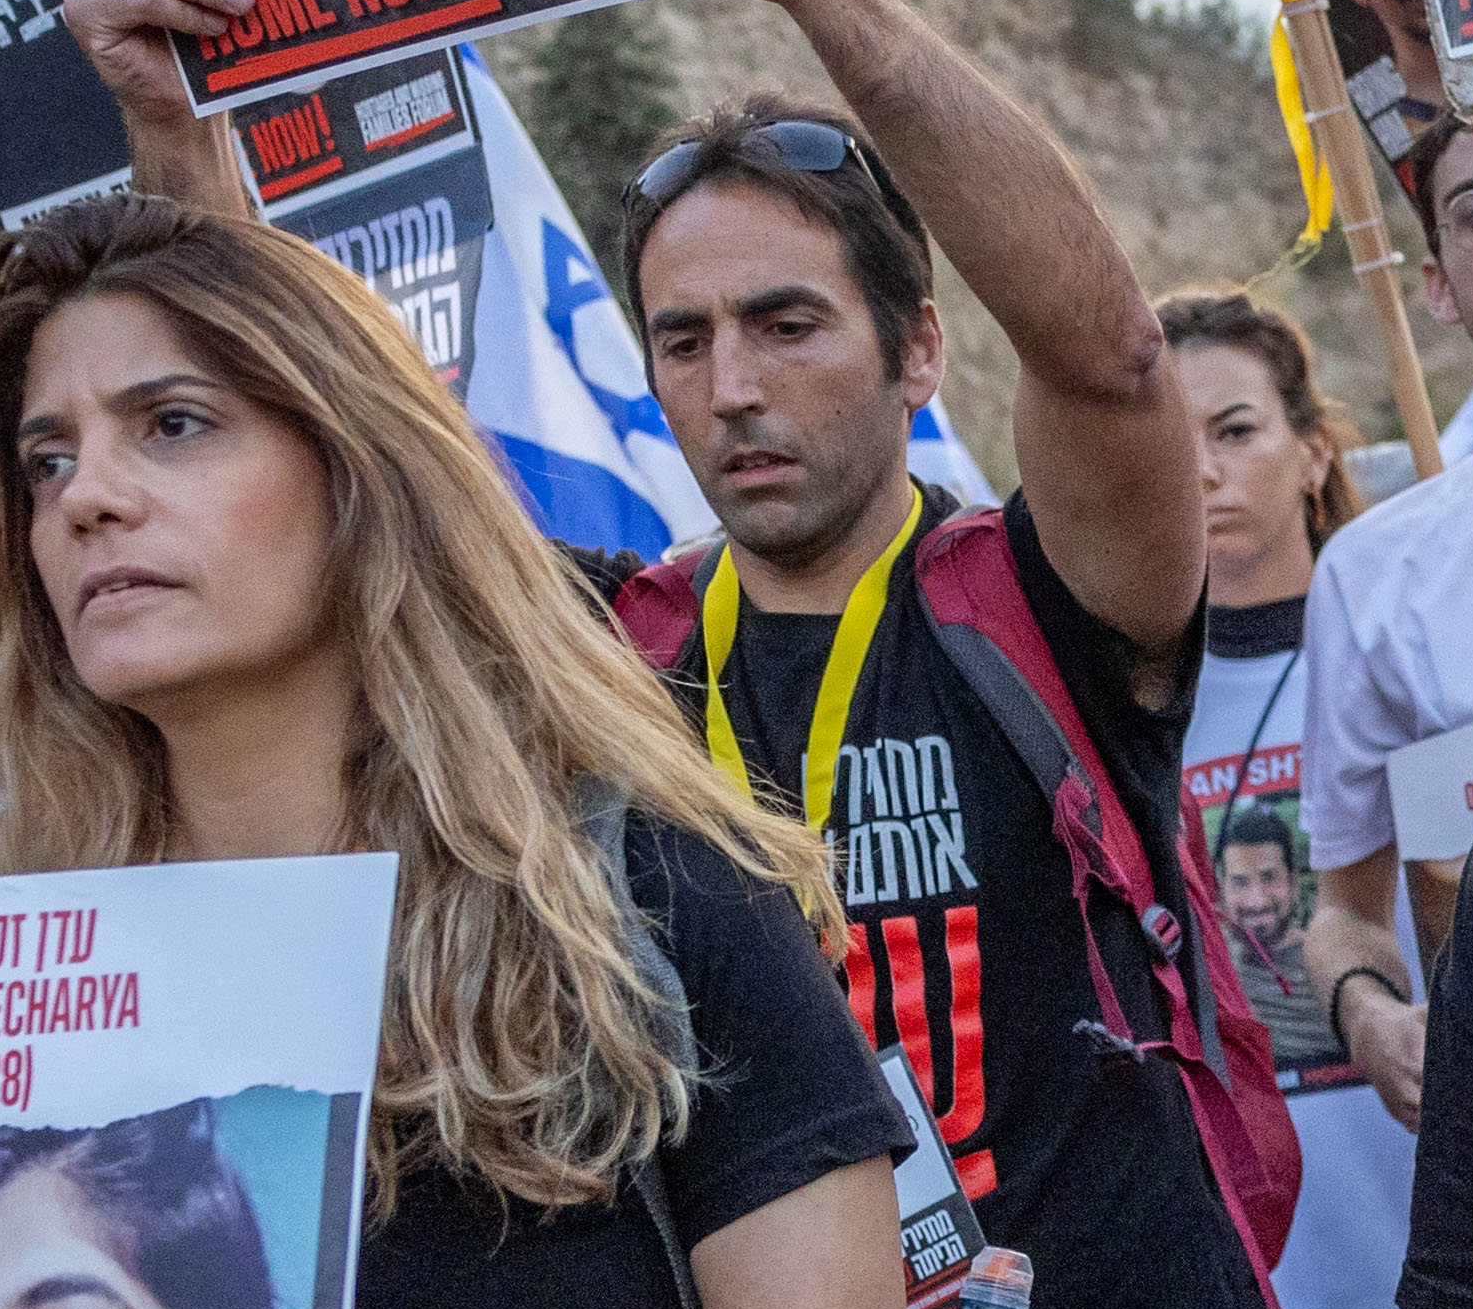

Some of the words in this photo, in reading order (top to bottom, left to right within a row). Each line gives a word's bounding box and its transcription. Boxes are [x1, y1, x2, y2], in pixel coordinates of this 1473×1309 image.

[250, 92, 335, 174] NOW!
[846, 811, 979, 907] אותם
[34, 907, 98, 974] עדן
